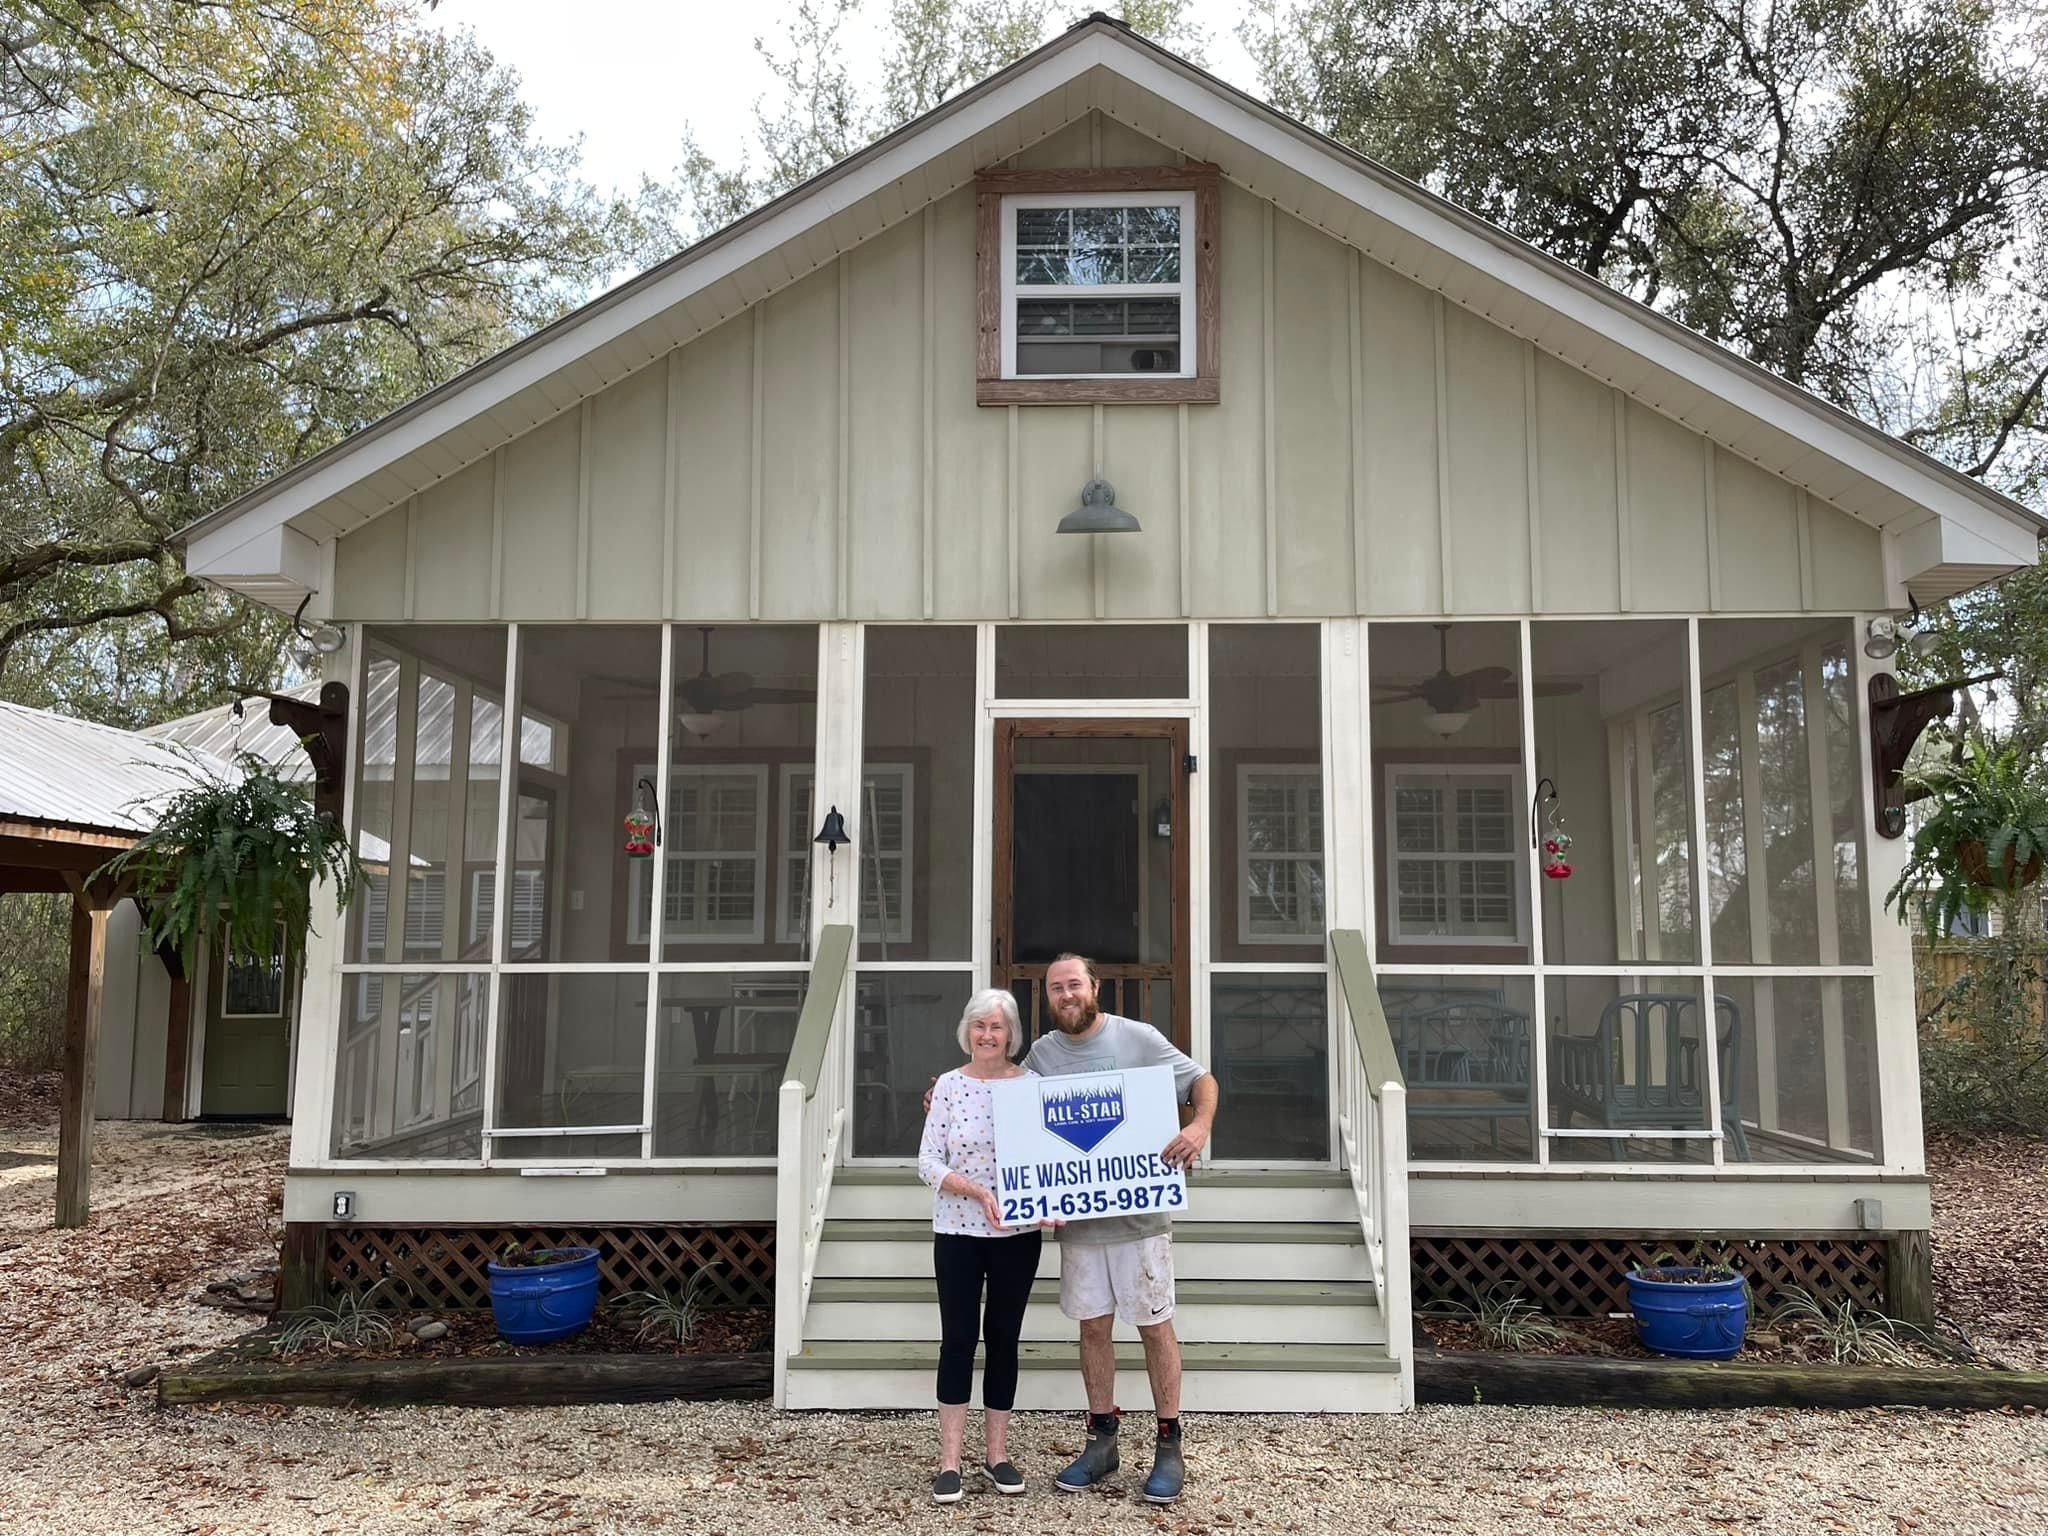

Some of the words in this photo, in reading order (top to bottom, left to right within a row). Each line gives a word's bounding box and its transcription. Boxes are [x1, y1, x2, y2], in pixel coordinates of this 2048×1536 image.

[1047, 1101, 1121, 1123] ALL-STAR
[1002, 1165, 1032, 1191] WE
[1036, 1159, 1092, 1188] WASH
[1003, 1183, 1183, 1221] 251-635-9873
